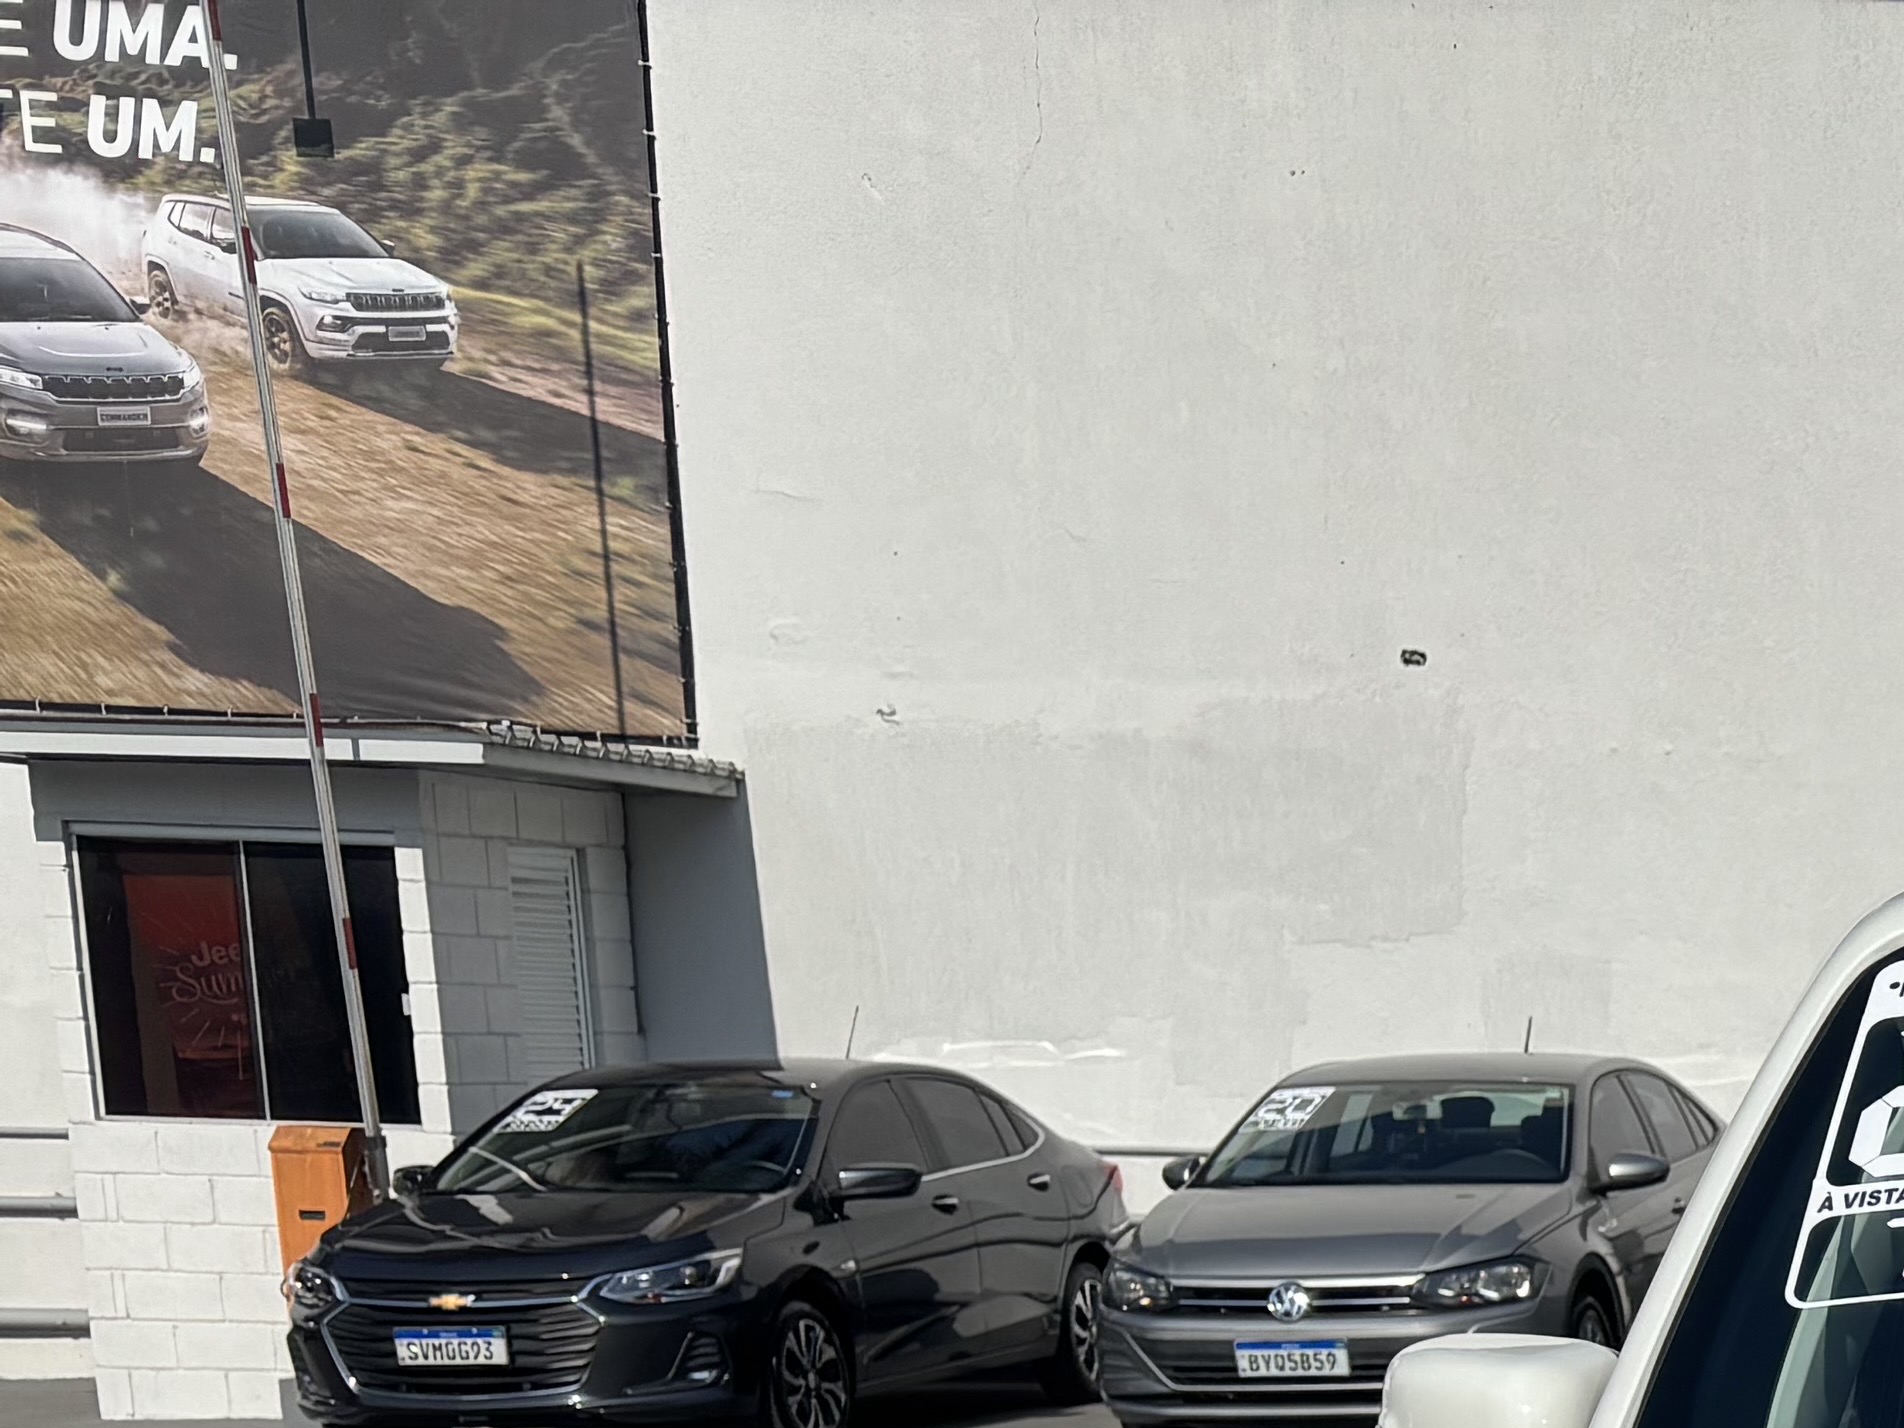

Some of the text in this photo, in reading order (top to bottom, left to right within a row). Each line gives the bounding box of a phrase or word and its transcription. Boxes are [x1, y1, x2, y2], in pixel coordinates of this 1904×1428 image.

[53, 0, 238, 70] UMA.
[87, 93, 215, 163] UM.
[191, 940, 241, 967] Jee
